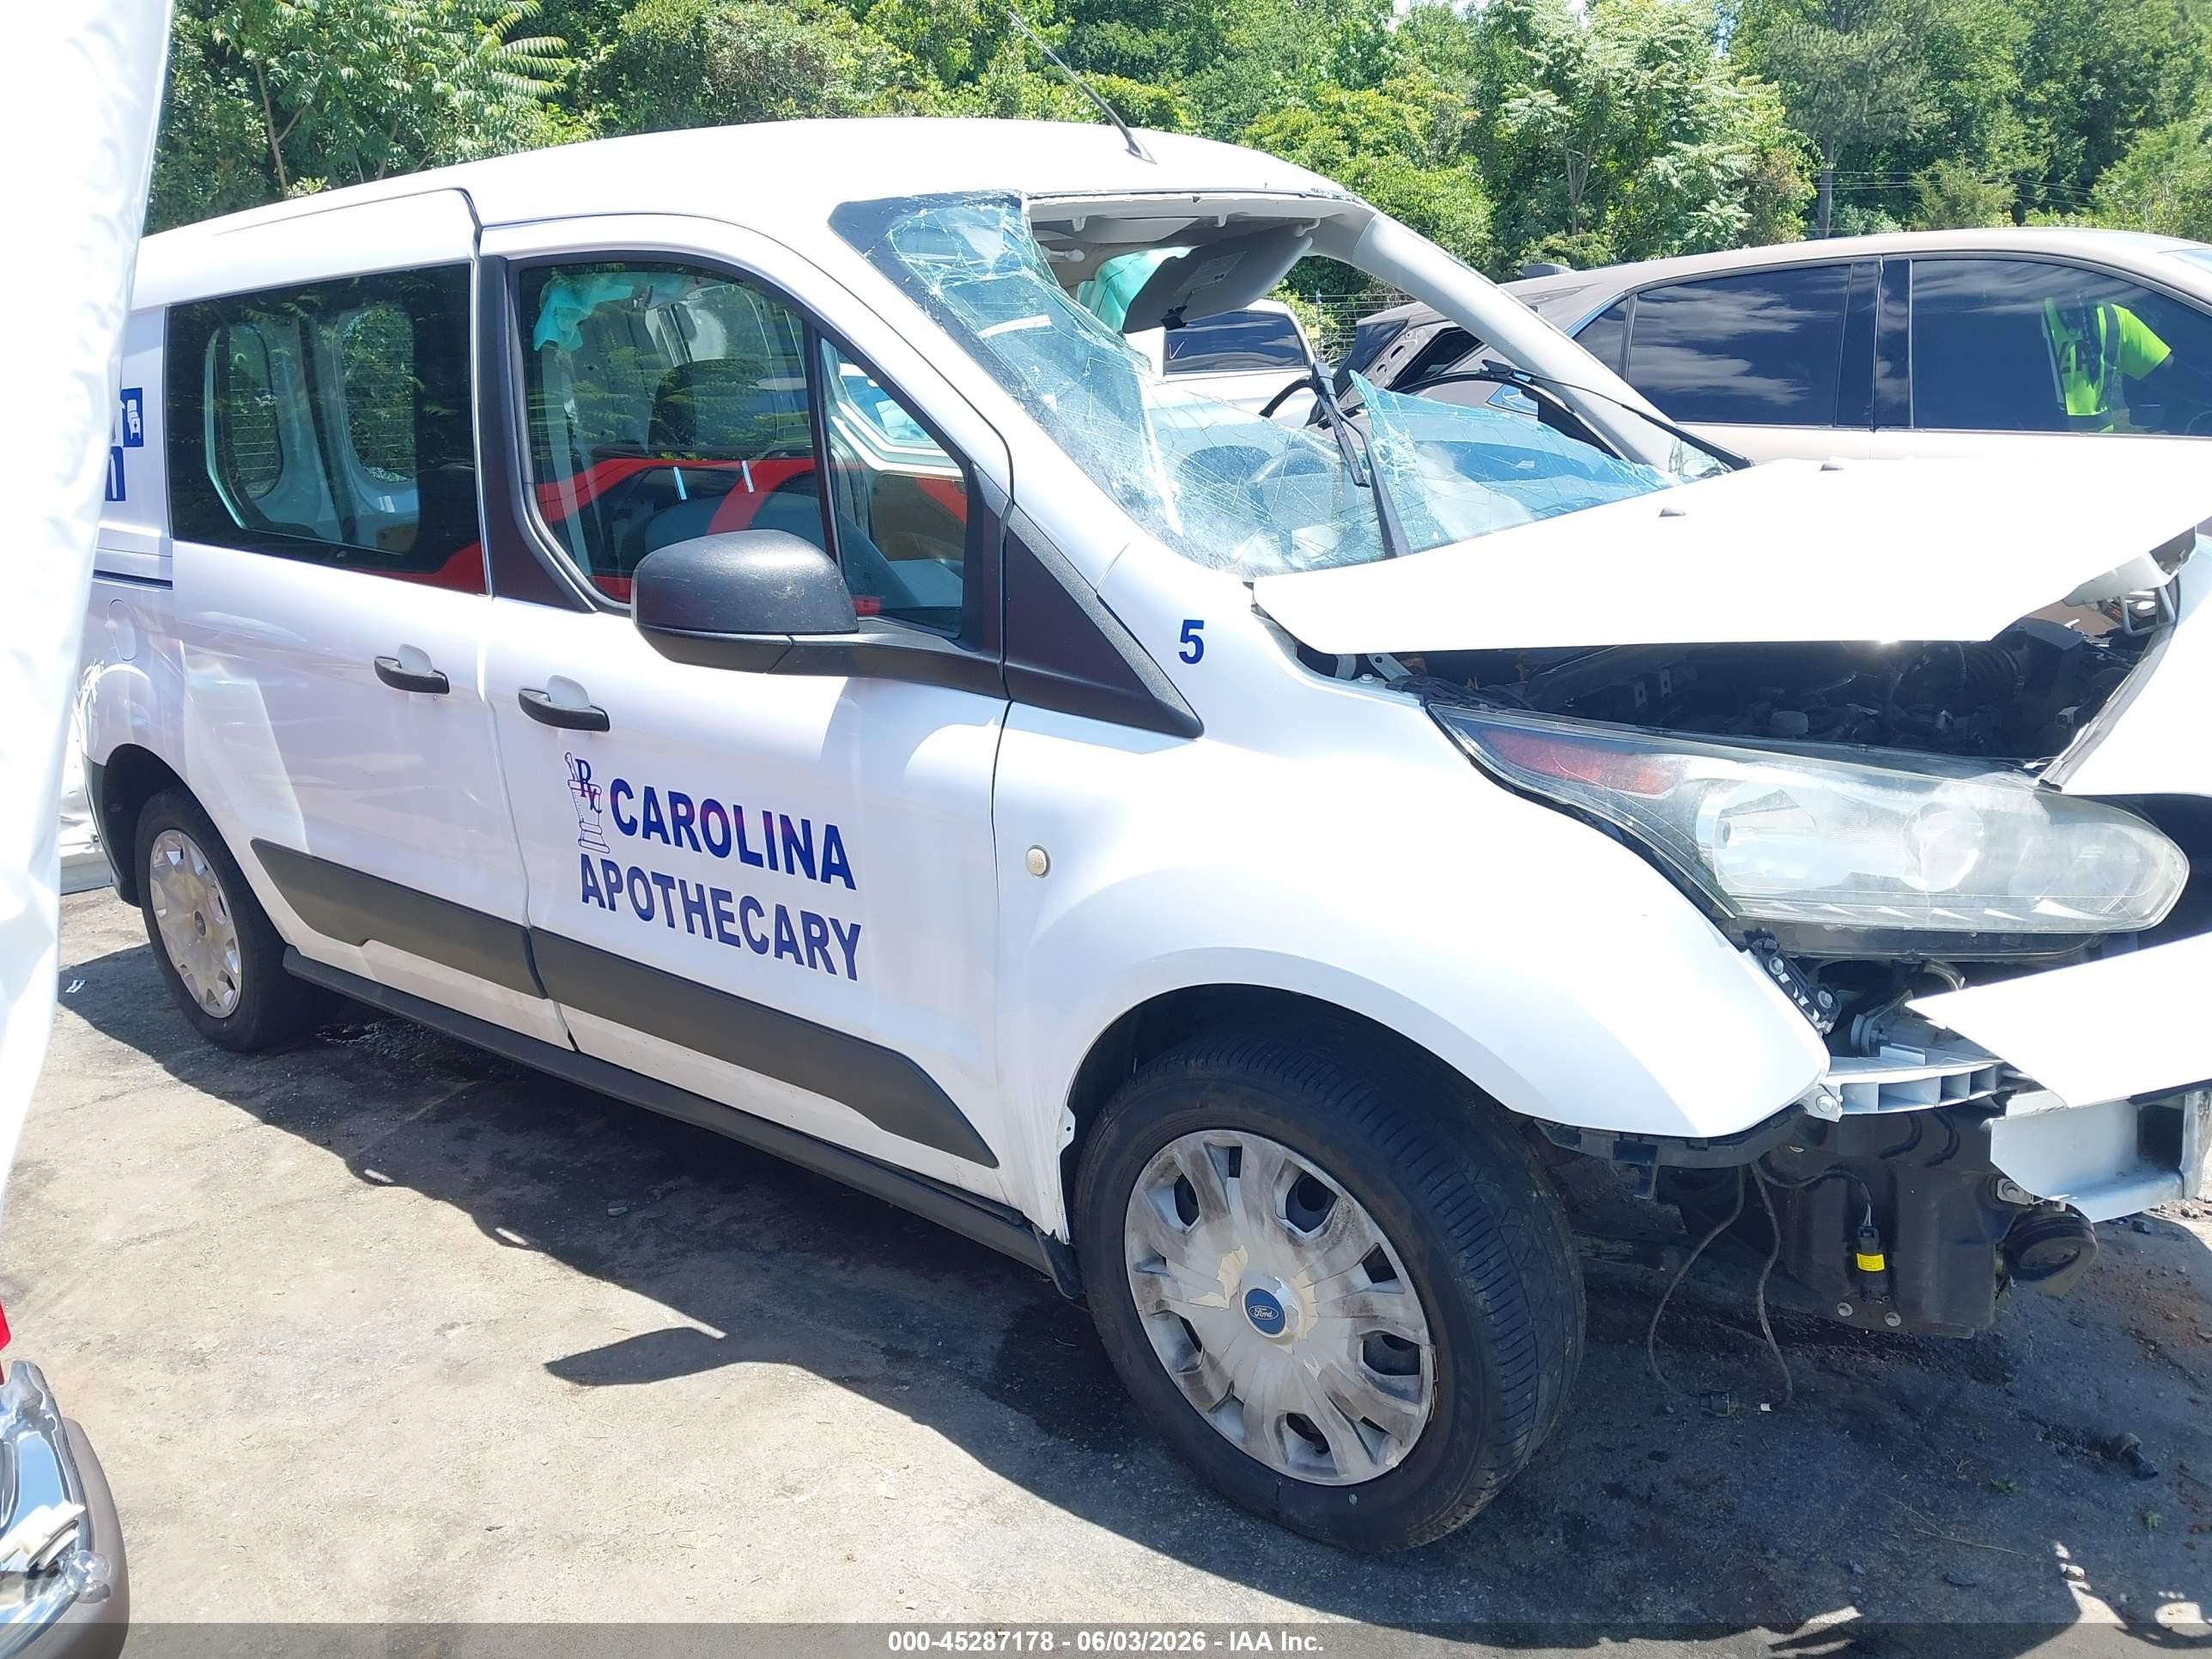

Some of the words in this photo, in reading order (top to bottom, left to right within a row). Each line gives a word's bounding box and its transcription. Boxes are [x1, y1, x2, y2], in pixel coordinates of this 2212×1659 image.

[1178, 619, 1205, 665] 5
[610, 778, 857, 890] CAROLINA
[580, 854, 861, 981] APOTHECARY
[1254, 1307, 1273, 1317] Ford
